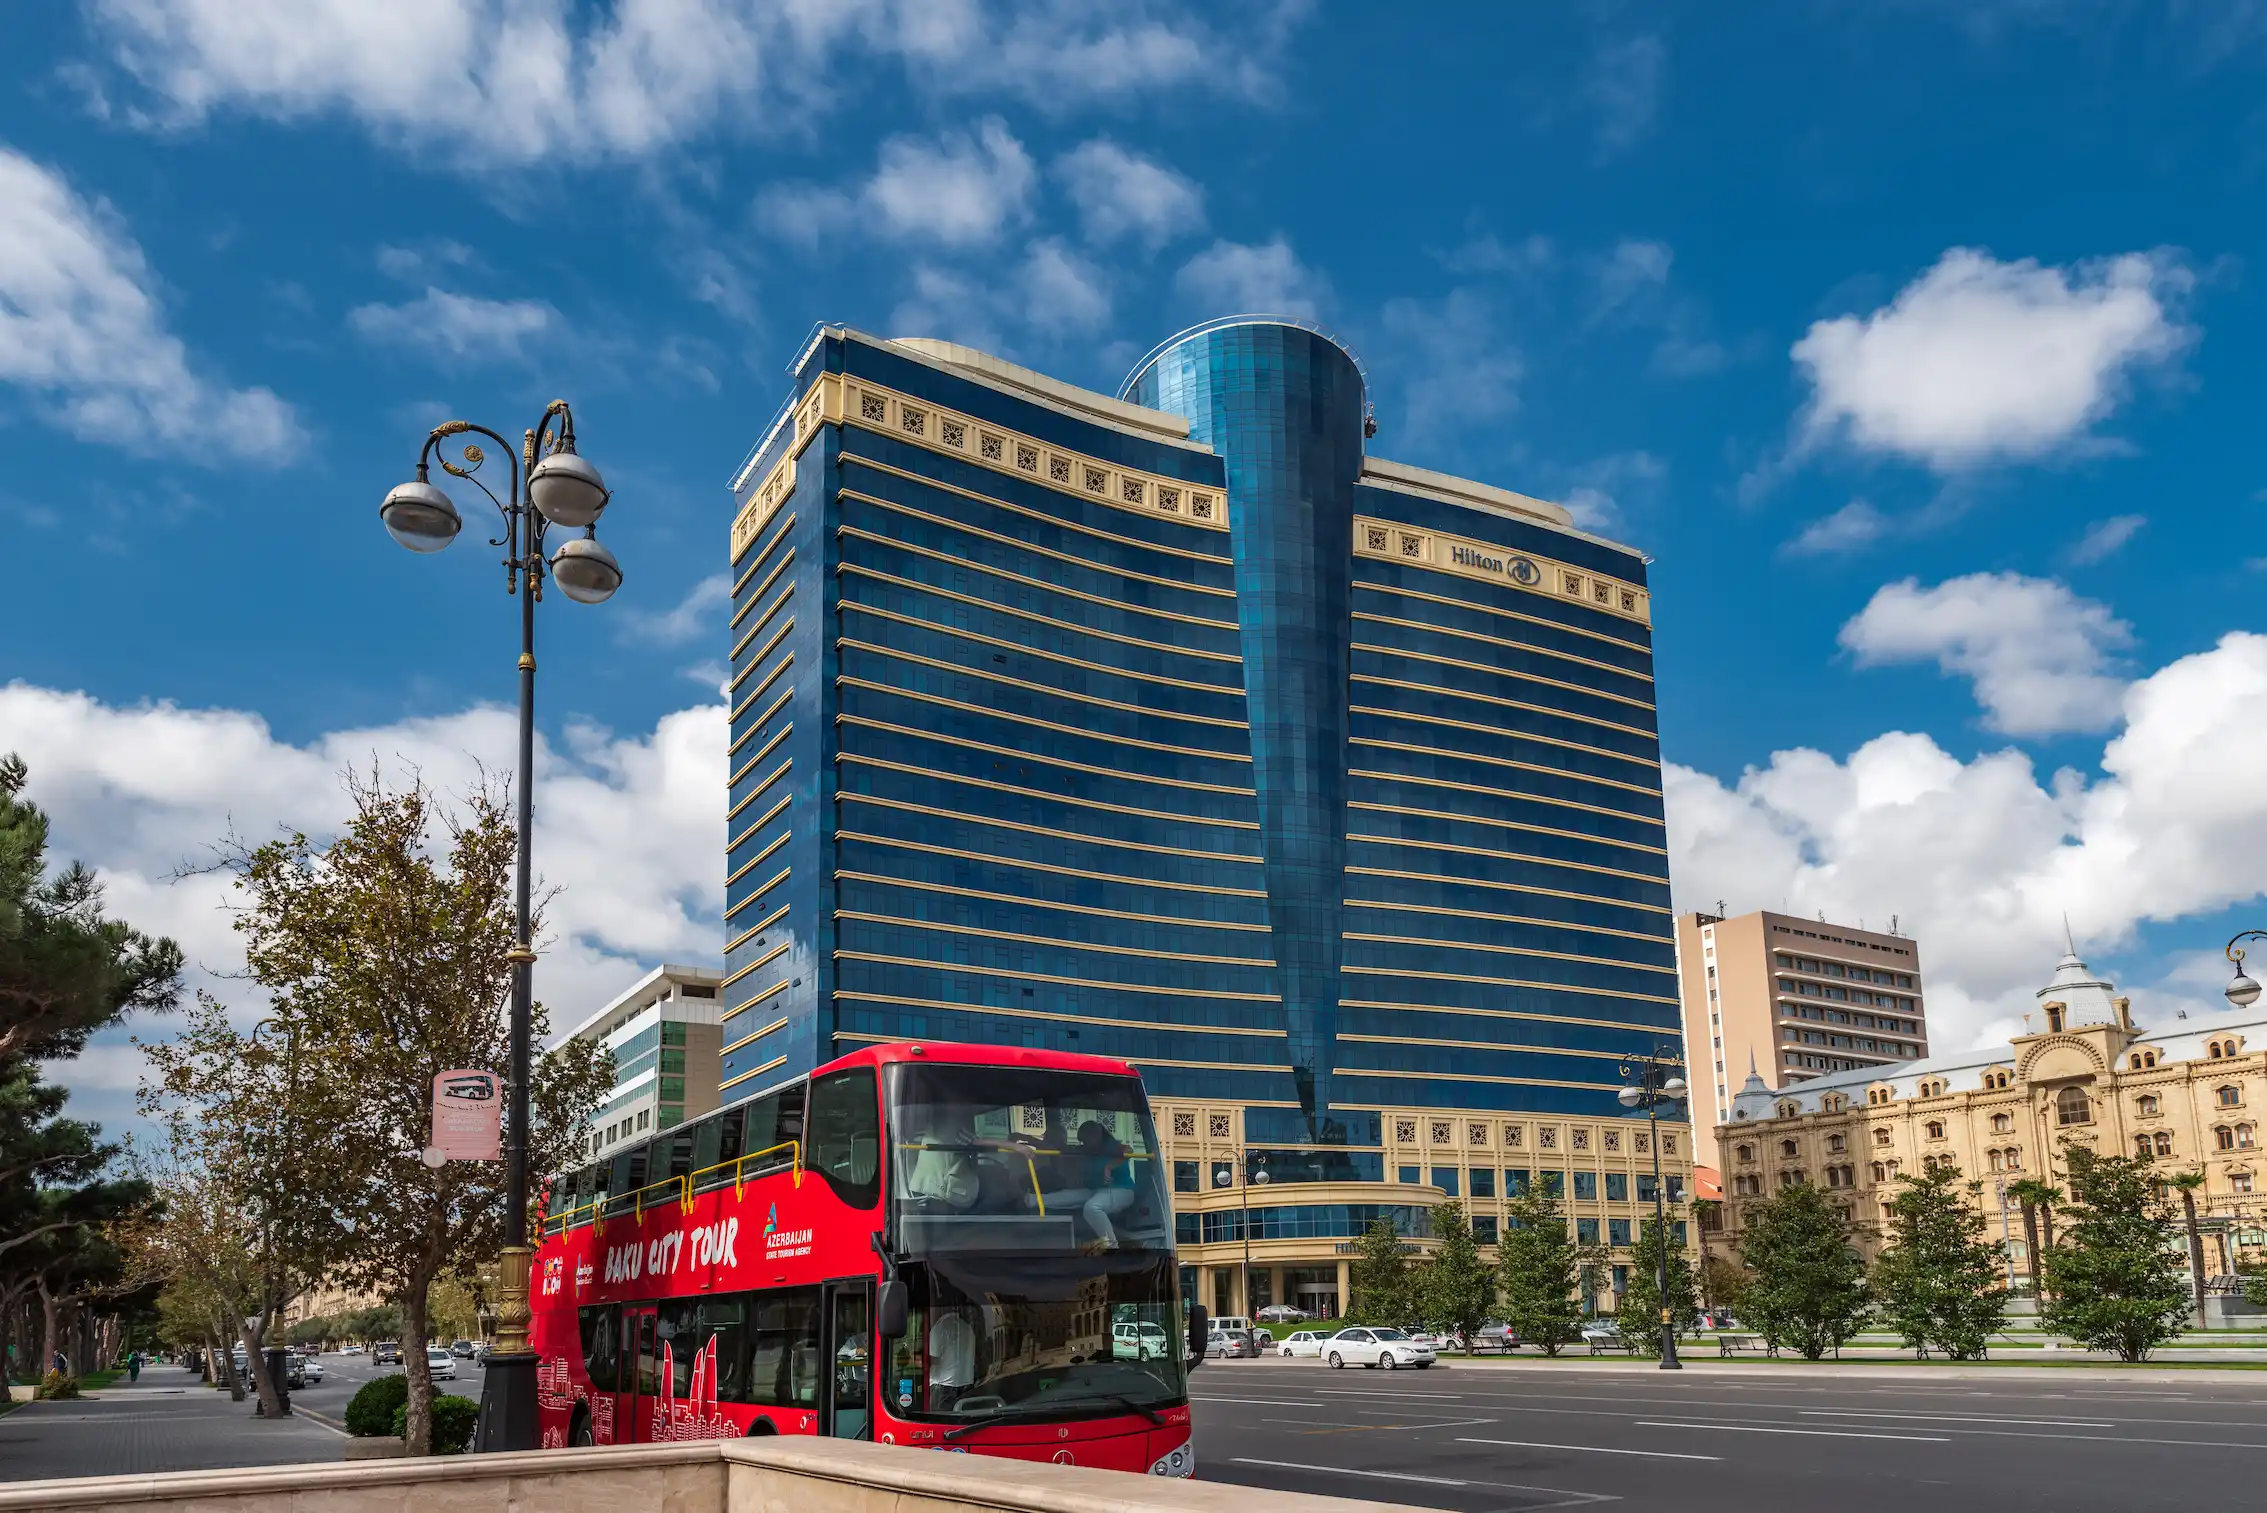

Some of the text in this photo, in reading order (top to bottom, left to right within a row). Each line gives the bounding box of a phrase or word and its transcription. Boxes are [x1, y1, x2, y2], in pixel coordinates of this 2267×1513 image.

[1451, 545, 1503, 573] Hilton
[604, 1216, 739, 1284] BAKU CITY TOUR
[766, 1228, 813, 1249] AZERBAIJAN
